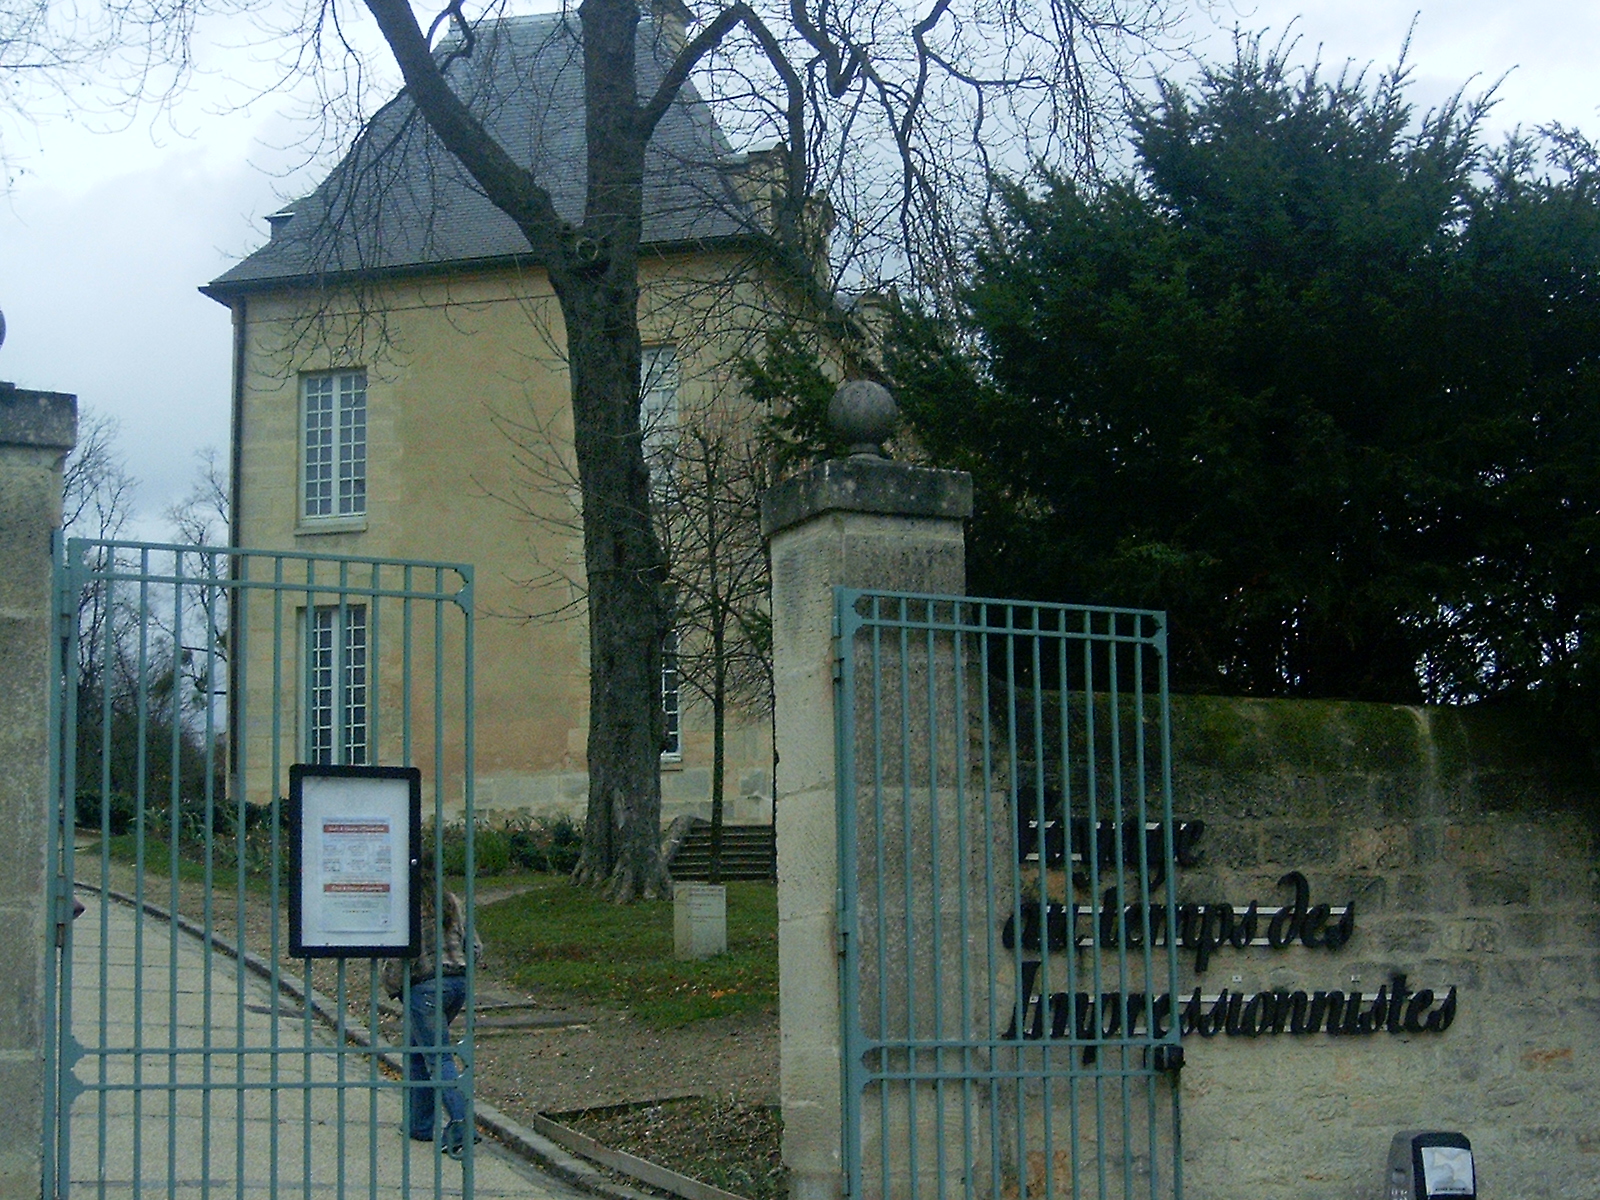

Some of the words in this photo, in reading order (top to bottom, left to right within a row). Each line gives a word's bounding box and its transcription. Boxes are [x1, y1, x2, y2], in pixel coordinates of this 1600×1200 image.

[1002, 903, 1080, 950] au
[1099, 887, 1257, 972] temps
[1268, 871, 1354, 949] des
[1002, 961, 1457, 1065] Impressionnistes
